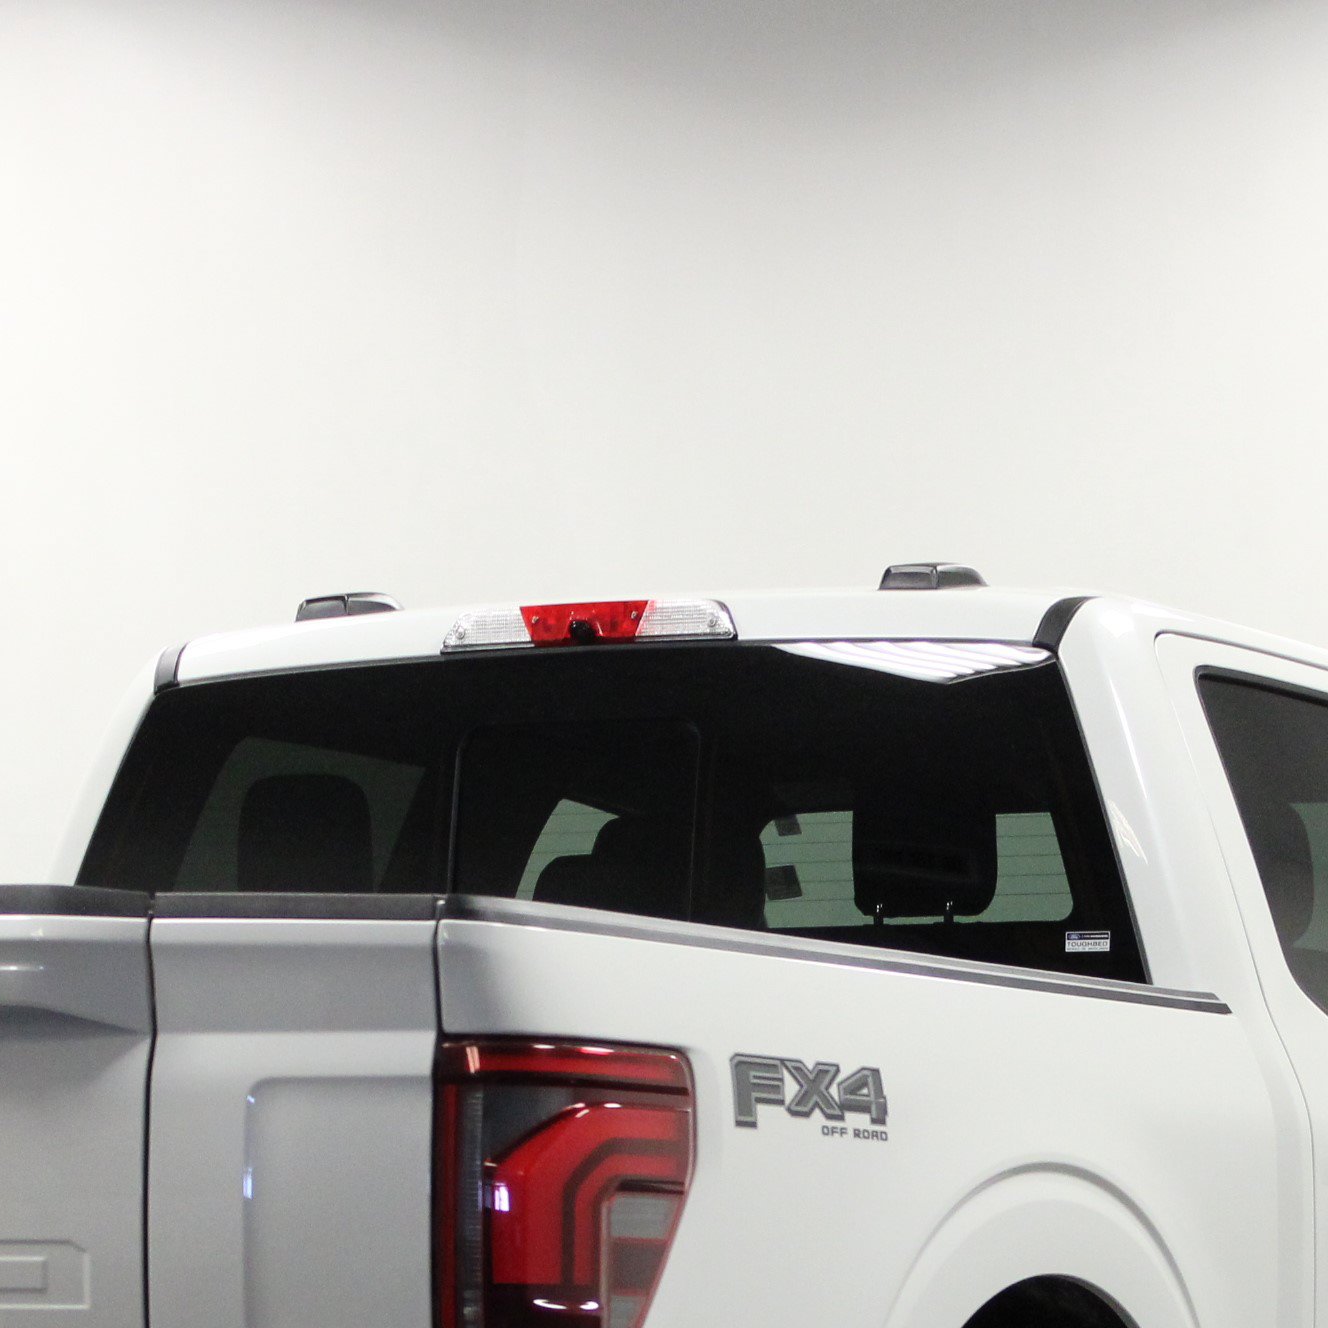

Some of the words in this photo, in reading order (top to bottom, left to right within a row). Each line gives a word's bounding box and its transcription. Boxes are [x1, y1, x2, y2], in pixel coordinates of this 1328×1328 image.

[729, 1053, 887, 1129] FX4
[821, 1125, 848, 1138] OFF
[853, 1127, 889, 1142] ROAD
